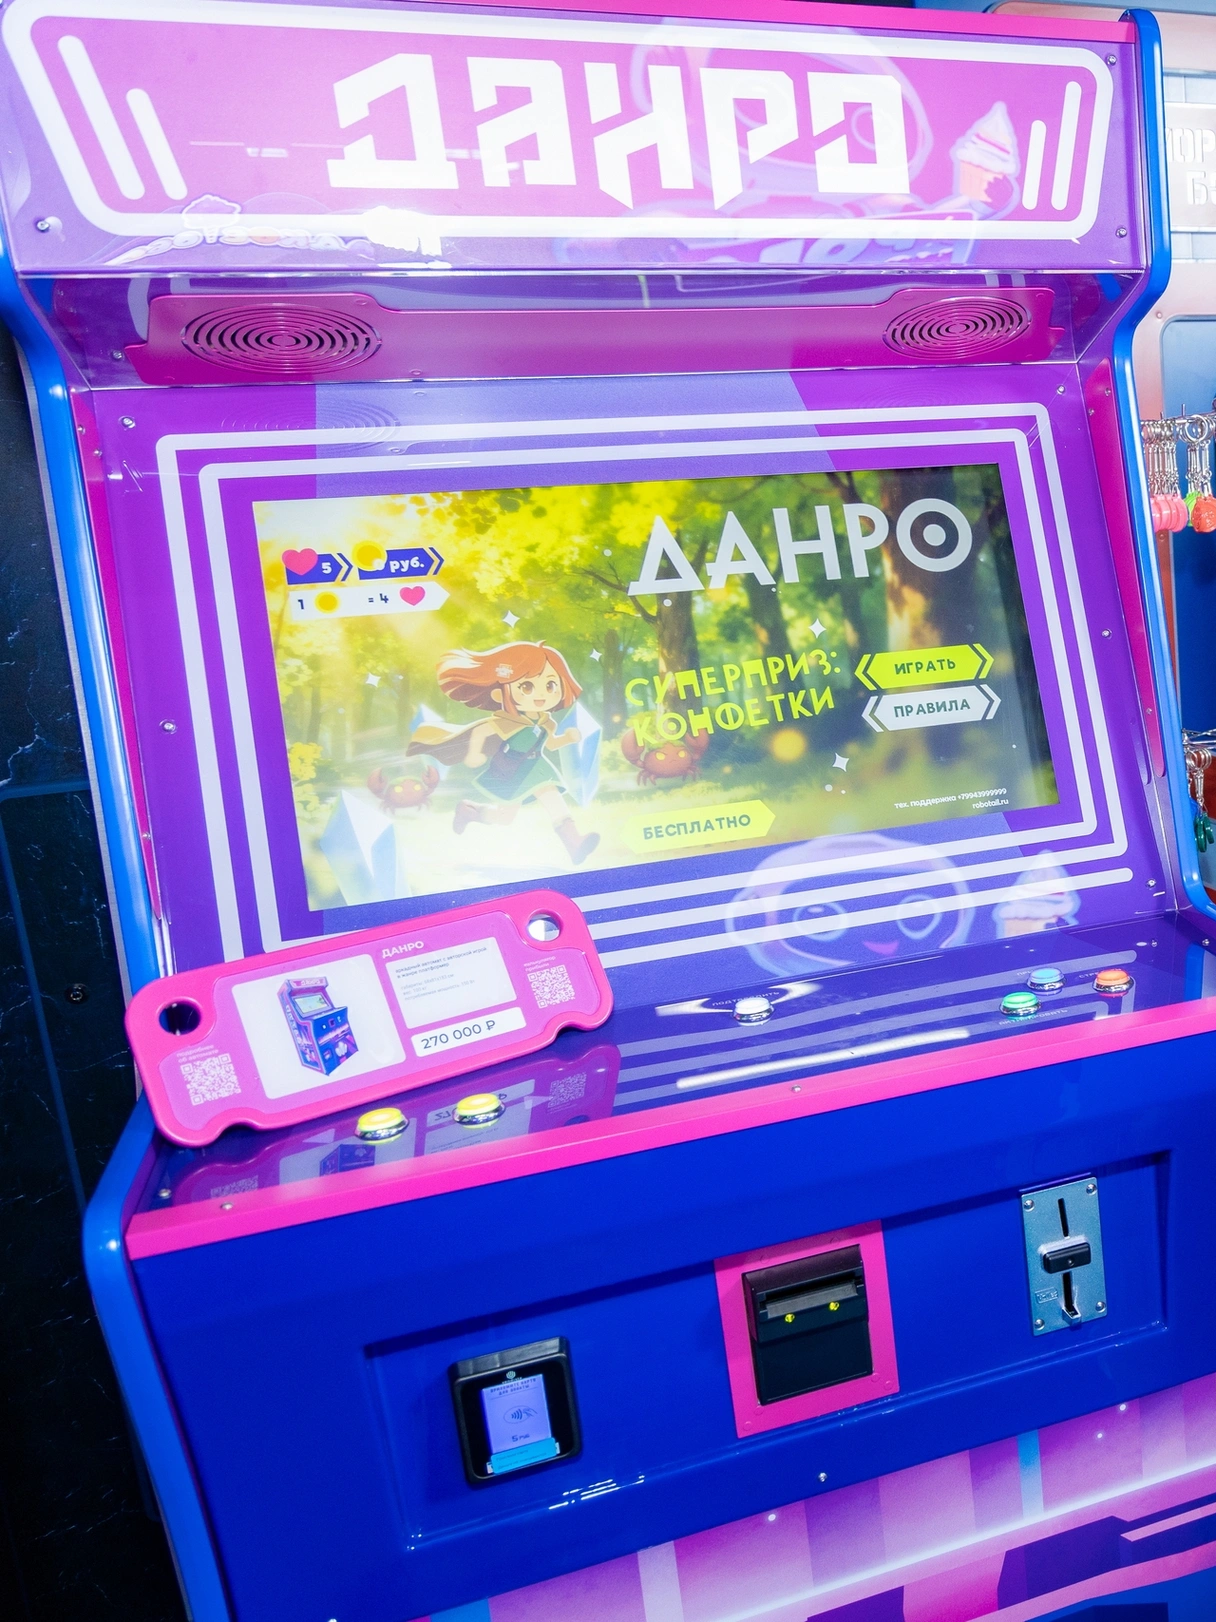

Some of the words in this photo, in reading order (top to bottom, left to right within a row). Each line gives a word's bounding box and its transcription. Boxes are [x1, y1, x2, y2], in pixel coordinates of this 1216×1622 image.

[628, 497, 973, 596] ДАНРО
[321, 562, 333, 575] 5
[389, 556, 426, 573] руб.
[298, 598, 305, 610] 1
[379, 593, 389, 604] 4
[894, 658, 957, 675] ИГРАТЬ
[624, 649, 842, 707] СУПЕРПРИЗ:
[633, 686, 835, 747] КОНФЕТКИ
[893, 698, 972, 719] ПРАВИЛА
[910, 795, 957, 807] поддержка
[642, 814, 752, 841] БЕСПЛАТНО
[381, 940, 425, 959] ДАНРО
[420, 1033, 449, 1049] 270
[453, 1023, 482, 1040] 000
